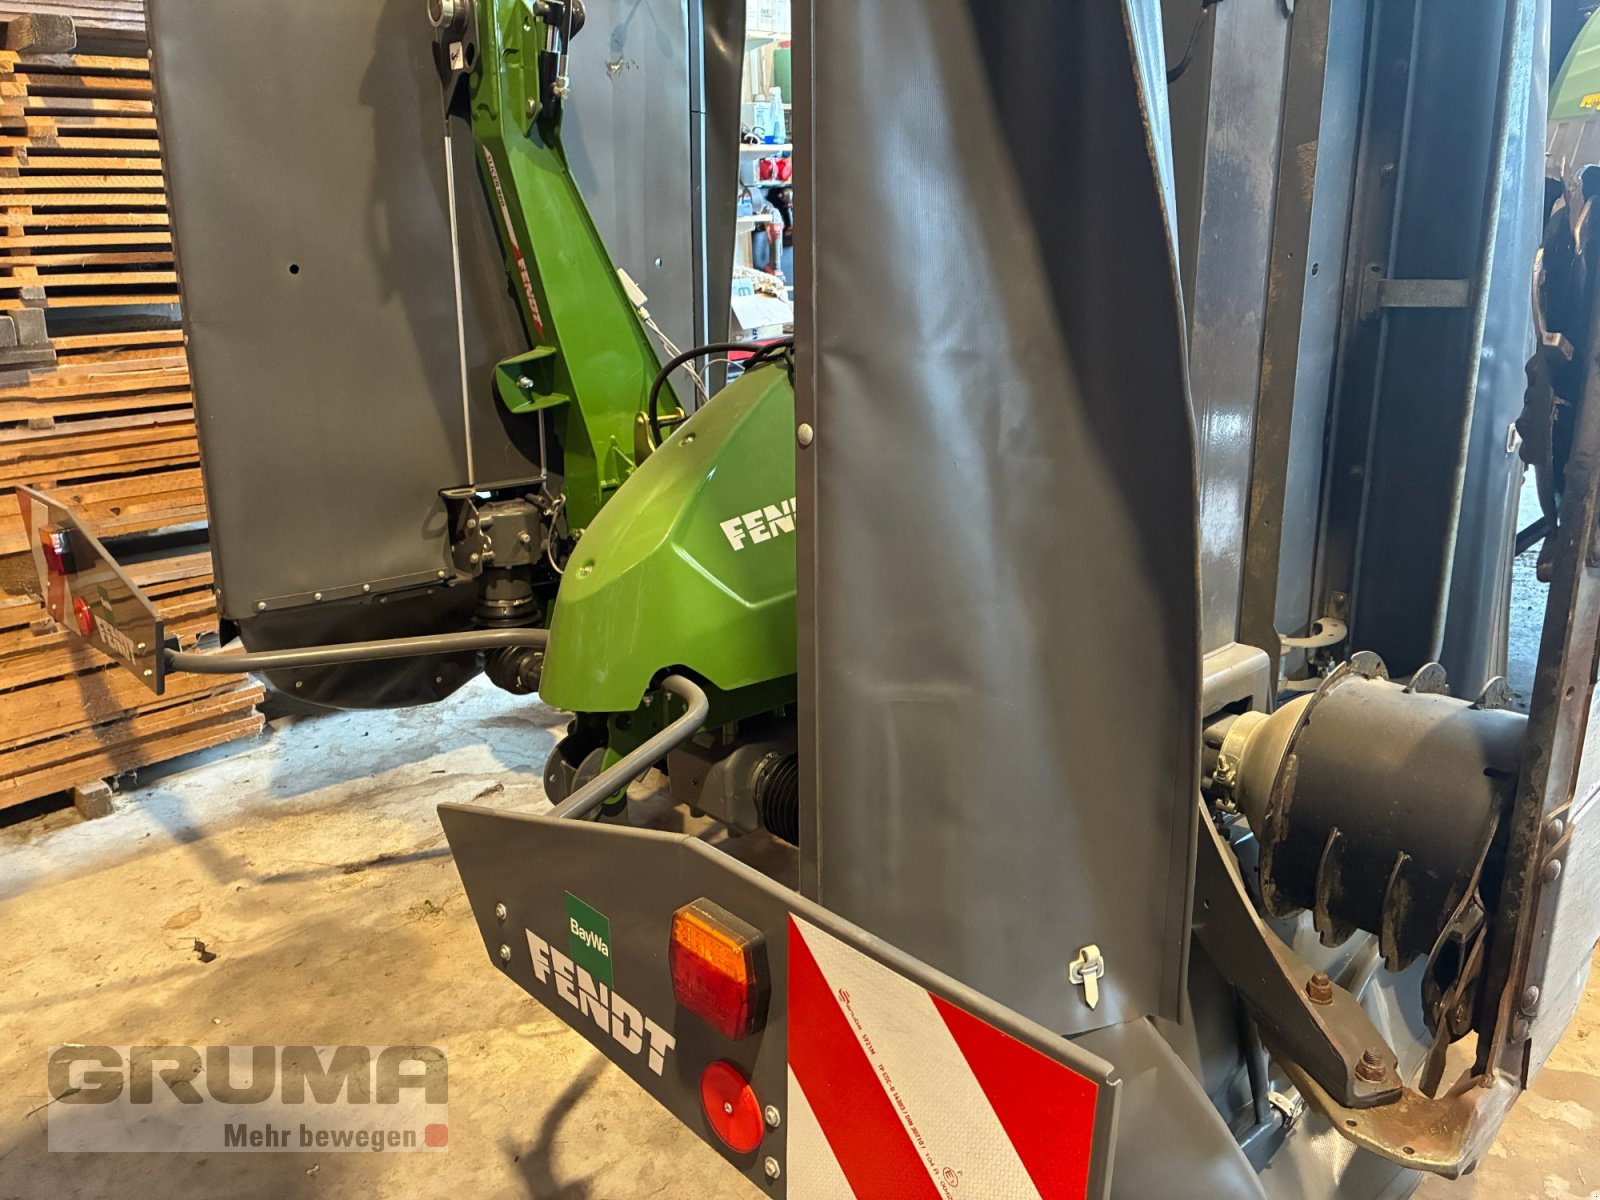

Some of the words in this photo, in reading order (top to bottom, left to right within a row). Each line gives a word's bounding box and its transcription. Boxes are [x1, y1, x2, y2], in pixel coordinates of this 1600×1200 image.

[517, 257, 543, 328] FENDT
[719, 496, 797, 552] FEN
[93, 614, 136, 666] FENDT
[570, 917, 609, 957] BayWa
[525, 928, 676, 1077] FENDT
